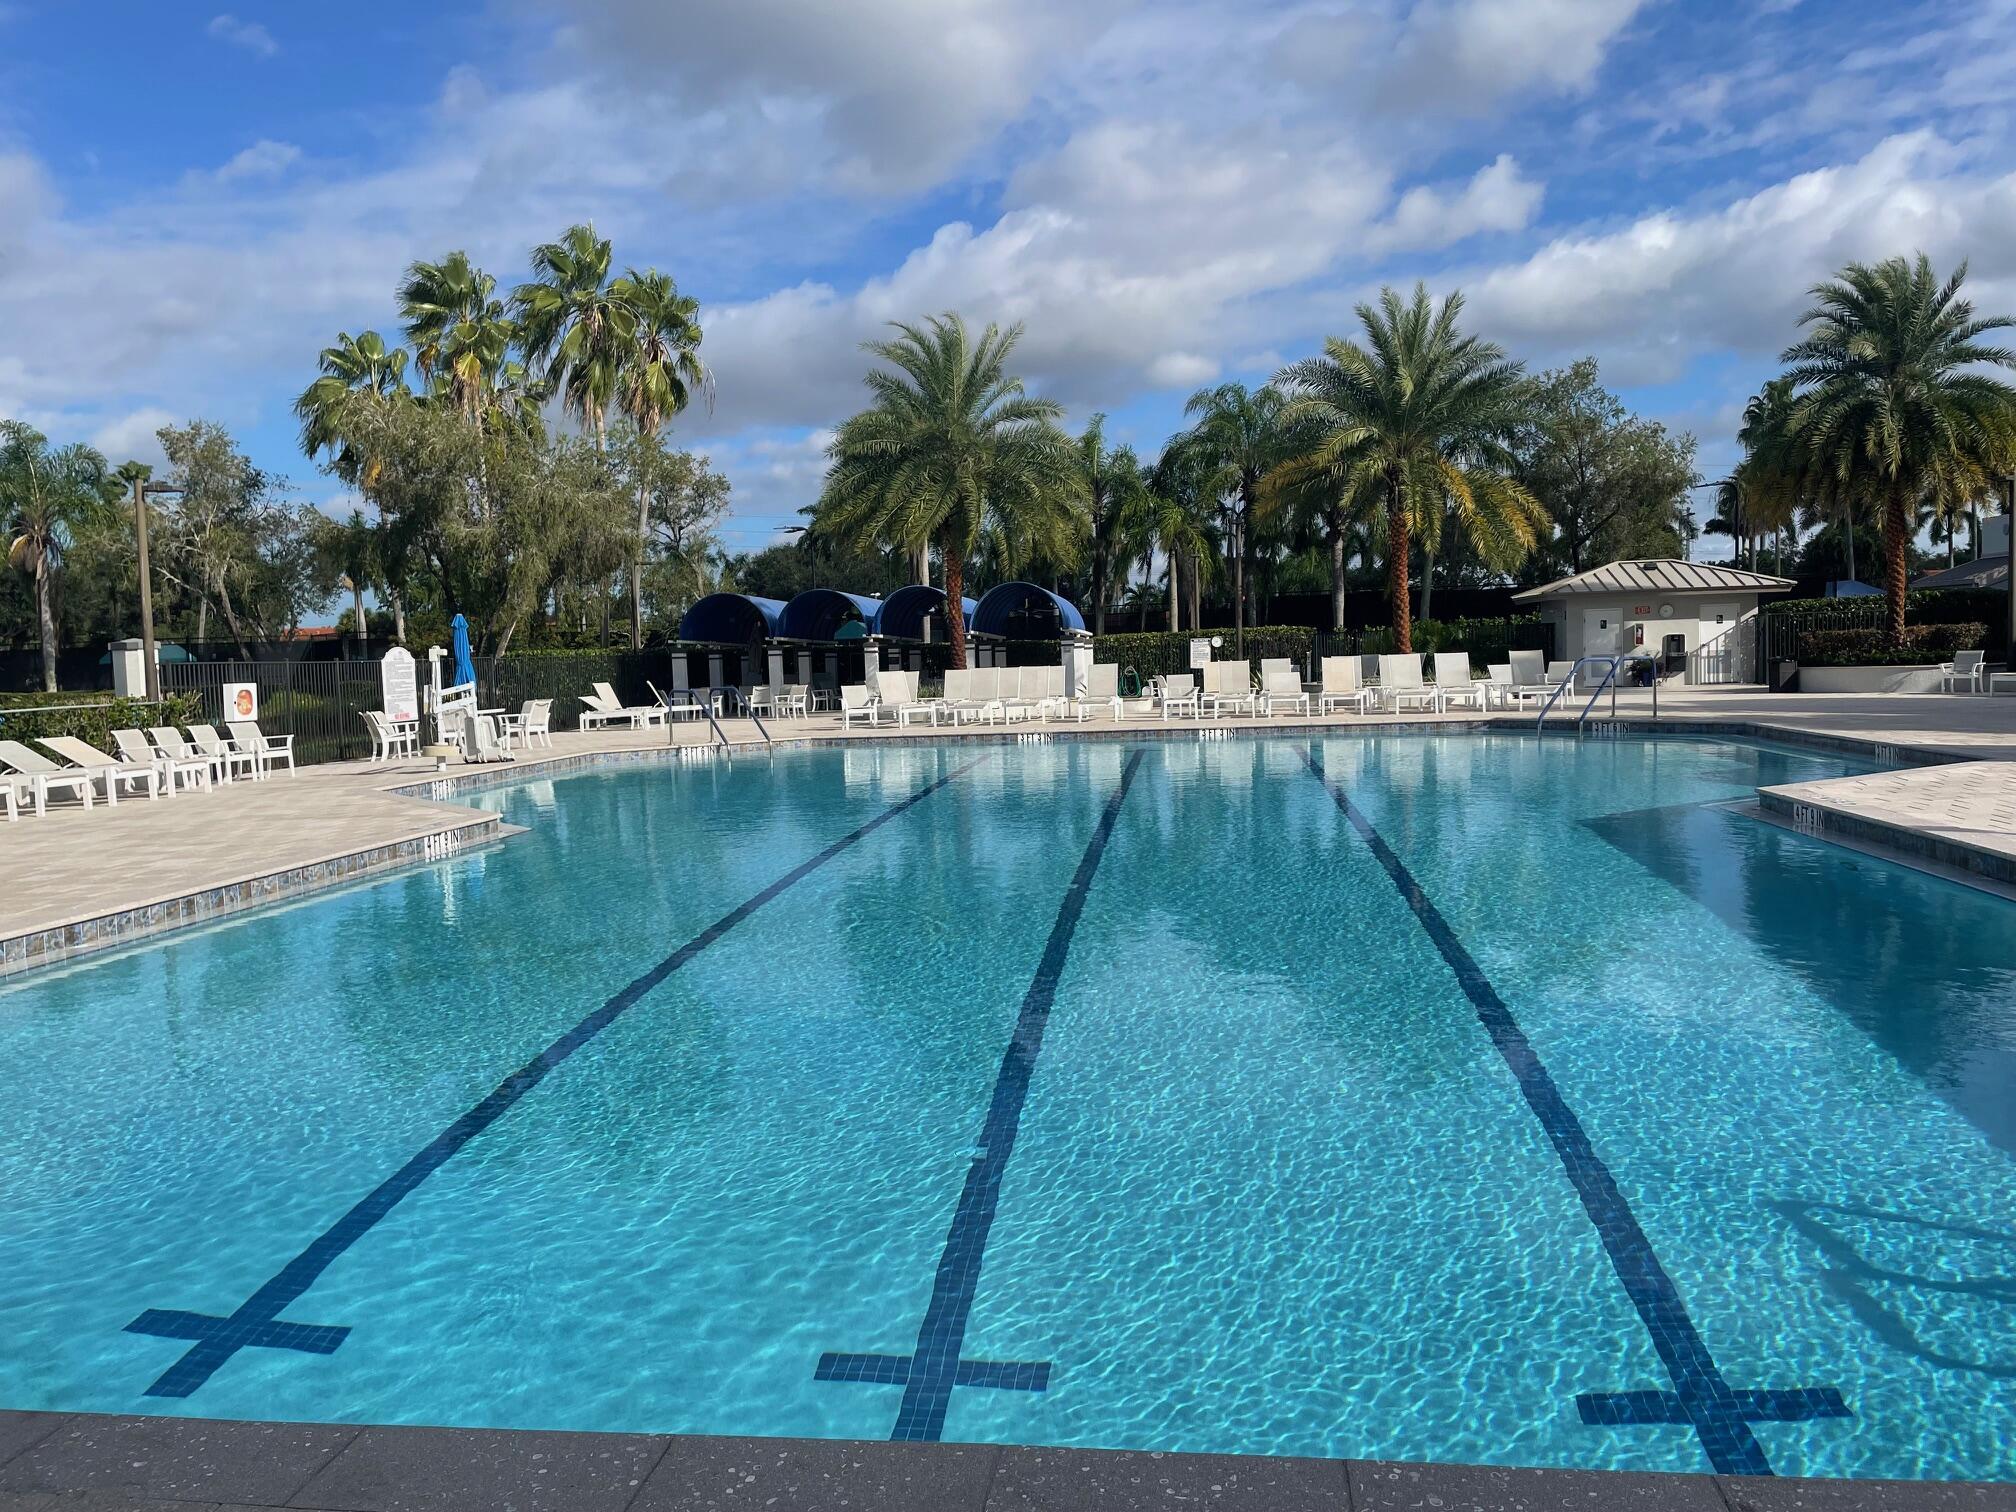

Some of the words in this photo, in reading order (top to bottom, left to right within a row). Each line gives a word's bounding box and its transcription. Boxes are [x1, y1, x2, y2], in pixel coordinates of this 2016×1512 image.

[1602, 722, 1609, 731] FT
[1620, 722, 1629, 731] IN
[1209, 728, 1216, 737] FT
[1227, 728, 1235, 737] IN
[1020, 733, 1024, 742] 3
[1027, 733, 1034, 742] FT
[1037, 733, 1041, 742] 3
[1044, 733, 1052, 742] IN
[1796, 805, 1800, 820] 4
[1801, 806, 1808, 823] FT
[1811, 808, 1815, 825] 9
[1816, 809, 1824, 828] IN
